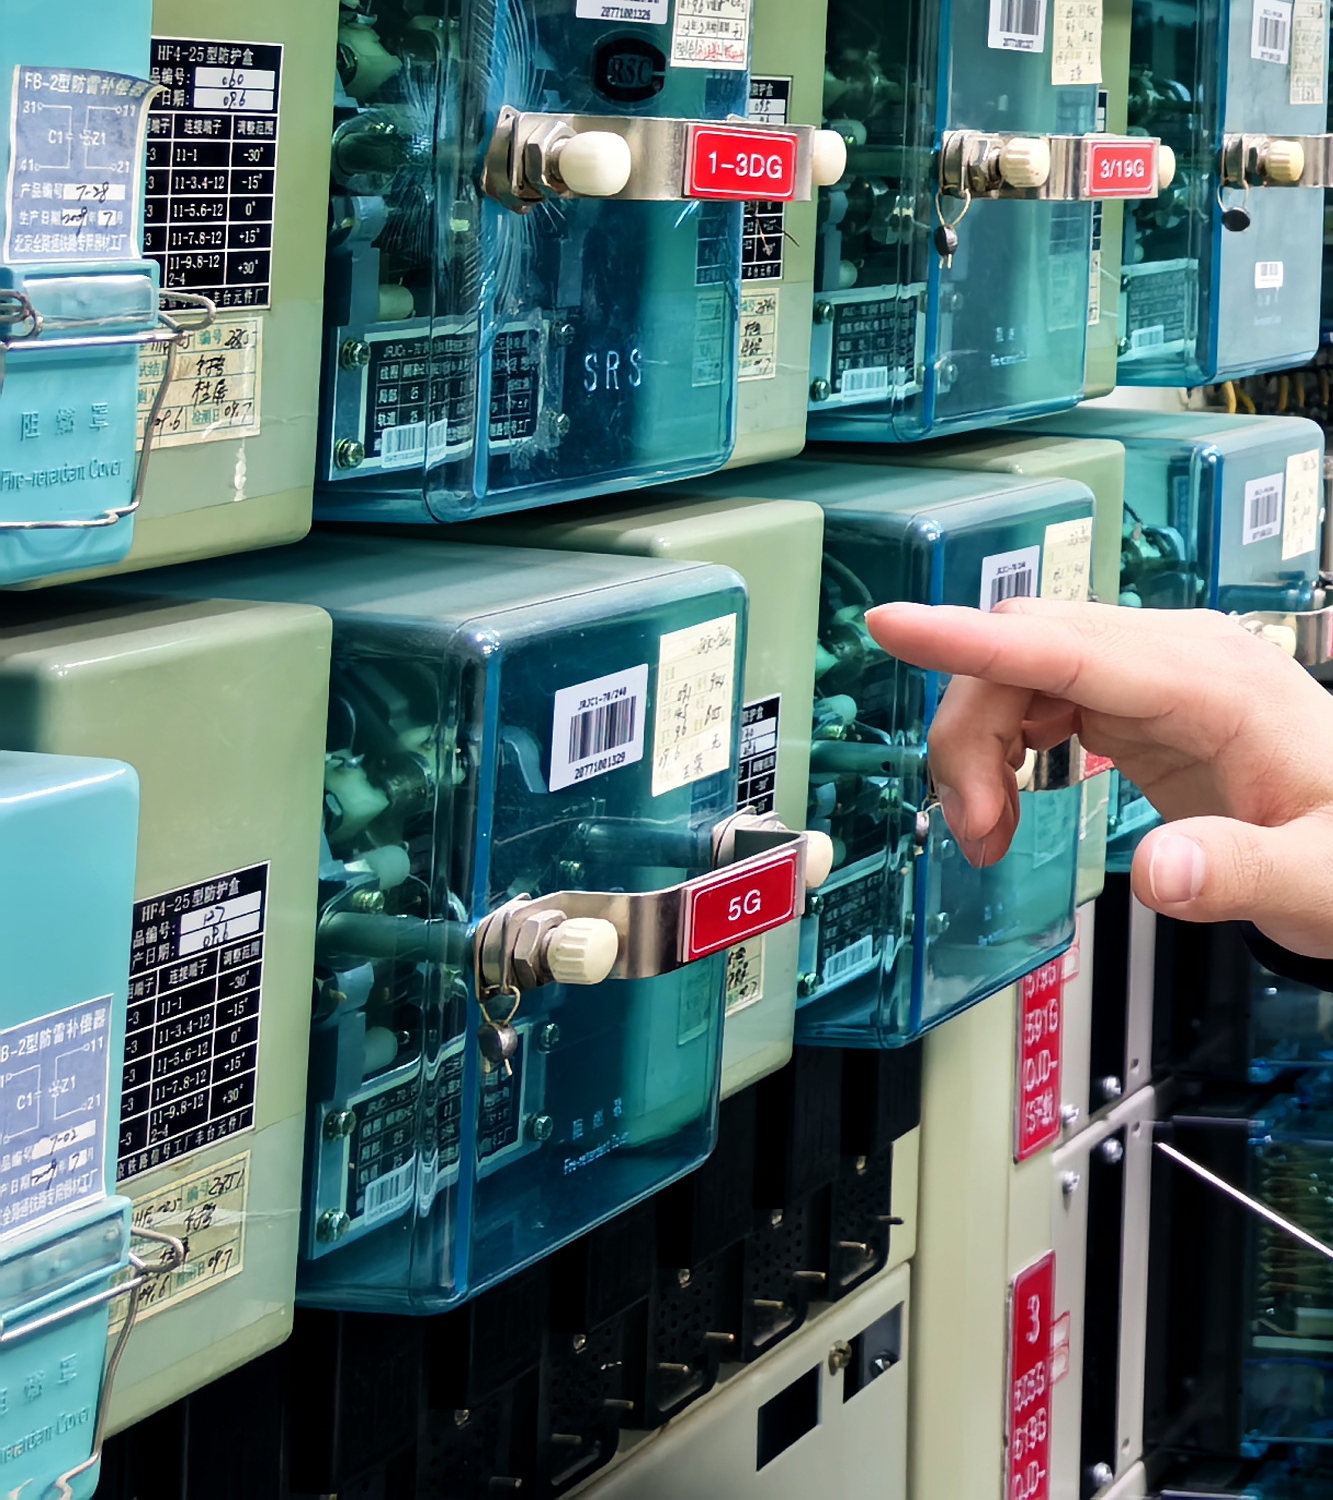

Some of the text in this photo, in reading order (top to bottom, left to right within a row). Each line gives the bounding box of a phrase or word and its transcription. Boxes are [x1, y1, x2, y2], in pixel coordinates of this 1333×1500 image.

[157, 44, 253, 66] HF4-25型防护盒
[23, 103, 36, 114] 31
[122, 105, 136, 116] 11
[147, 117, 171, 135] 端子
[183, 118, 222, 136] 连接端子
[48, 130, 63, 144] C1
[92, 130, 106, 145] Z1
[176, 148, 198, 162] 11-1
[243, 147, 264, 162] -30°
[19, 160, 34, 172] 41
[117, 161, 130, 173] 21
[708, 152, 783, 181] 1-3DG
[1100, 157, 1145, 180] 3/19G
[174, 176, 225, 190] 11-3、4-12
[241, 174, 263, 189] -15°
[173, 204, 224, 218] 11-5、6-12
[245, 201, 256, 216] 0°
[172, 231, 222, 246] 11-7、8-12
[239, 227, 260, 243] +15°
[169, 254, 220, 269] 11-9、8-12
[238, 260, 259, 276] +30°
[168, 273, 186, 286] 2-4
[141, 877, 241, 923] HF4-25型防护盒
[727, 889, 762, 921] 5G
[88, 1036, 104, 1053] 11
[60, 1075, 76, 1093] Z1
[16, 1091, 33, 1111] C1
[87, 1093, 101, 1112] 21
[1026, 1294, 1040, 1344] 3
